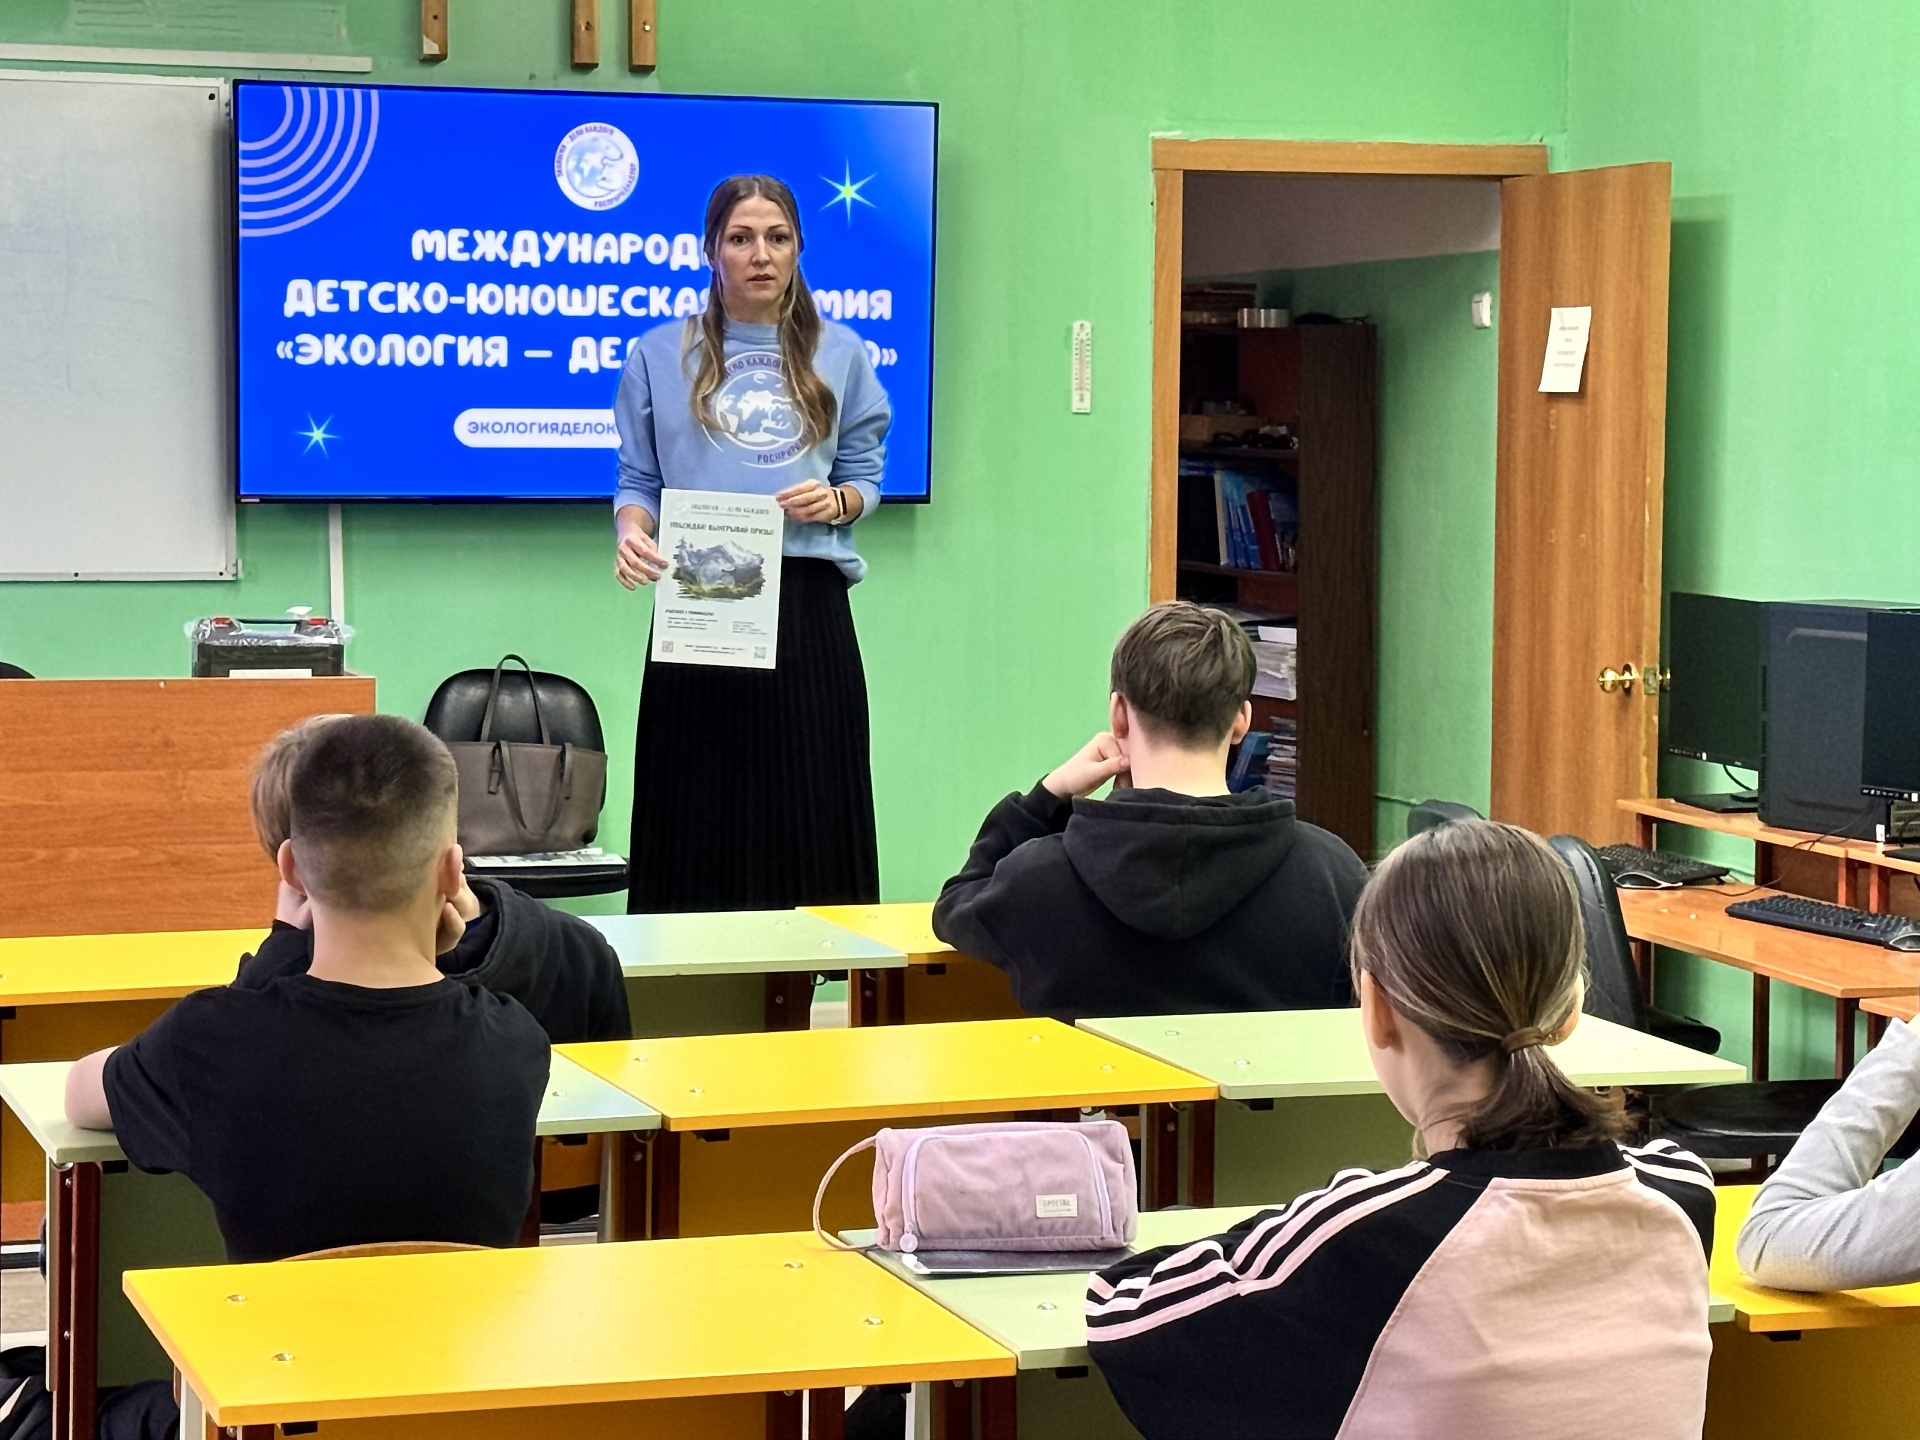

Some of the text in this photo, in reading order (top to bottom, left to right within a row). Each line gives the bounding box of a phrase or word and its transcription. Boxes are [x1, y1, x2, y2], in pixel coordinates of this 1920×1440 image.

[411, 228, 712, 271] МЕЖДУНАРОД
[812, 288, 893, 321] МИЯ
[276, 332, 509, 367] «ЭКОЛОГИЯ
[467, 421, 618, 436] ЭКОЛОГИЯДЕЛОК
